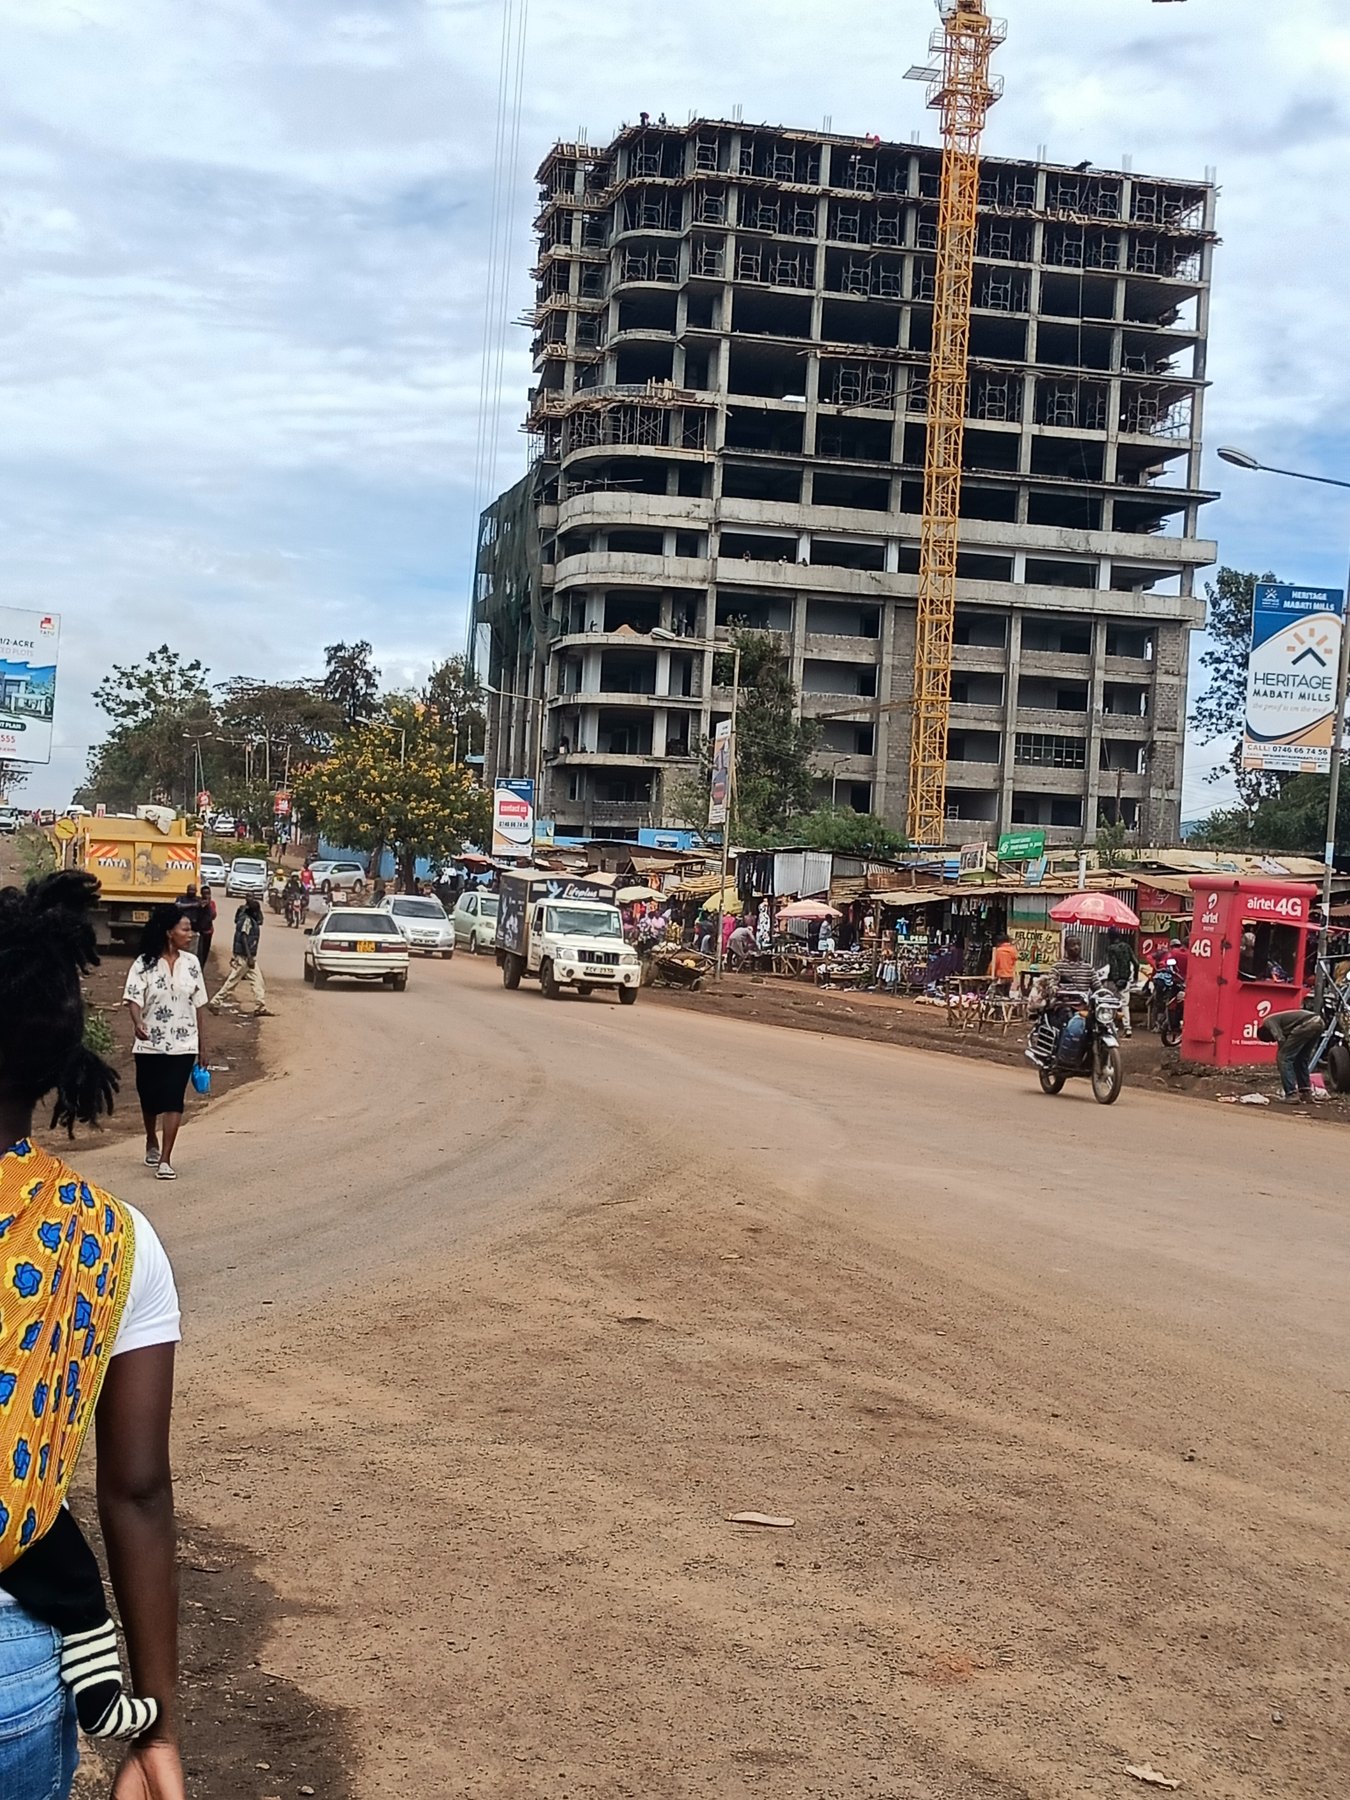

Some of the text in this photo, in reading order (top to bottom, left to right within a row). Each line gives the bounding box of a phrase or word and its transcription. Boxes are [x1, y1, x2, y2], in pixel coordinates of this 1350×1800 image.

[1254, 672, 1333, 690] HERITAGE
[1252, 688, 1331, 702] MABATI MILLS
[1247, 744, 1270, 752] CALL:
[98, 858, 127, 868] TATA
[166, 860, 194, 870] TATA
[1247, 897, 1302, 917] airtel 4G
[1201, 911, 1219, 924] airtel
[1191, 939, 1212, 957] 4G
